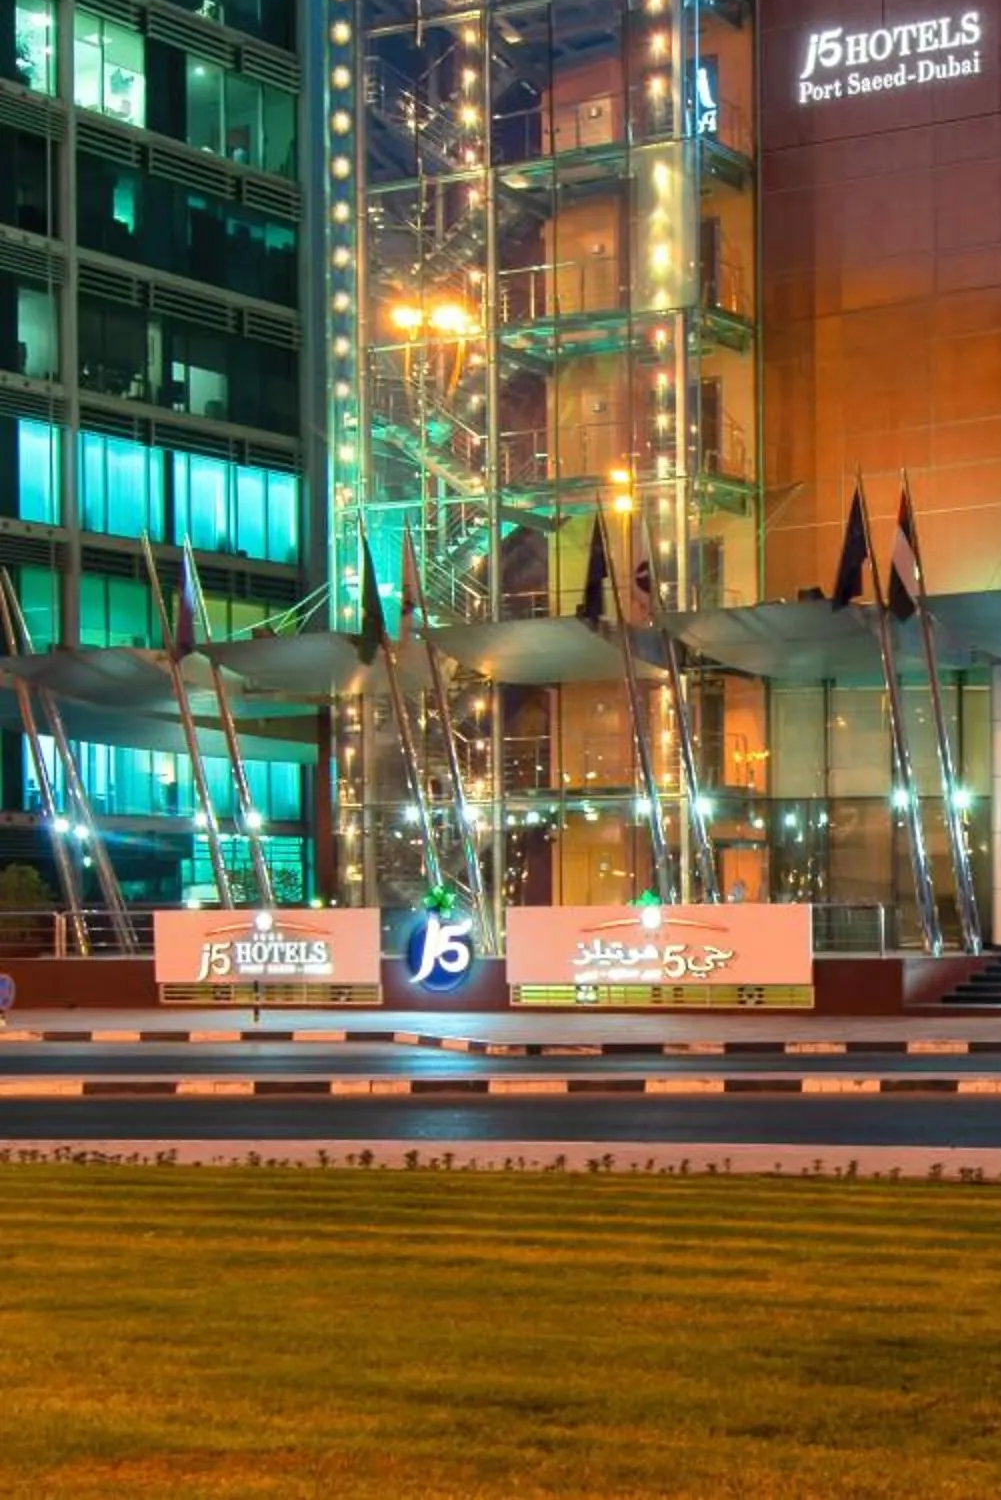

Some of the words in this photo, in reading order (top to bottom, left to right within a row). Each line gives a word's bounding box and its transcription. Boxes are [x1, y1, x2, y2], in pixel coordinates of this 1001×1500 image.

[845, 11, 981, 66] HOTELS
[799, 79, 842, 104] Port
[235, 940, 328, 964] HOTELS
